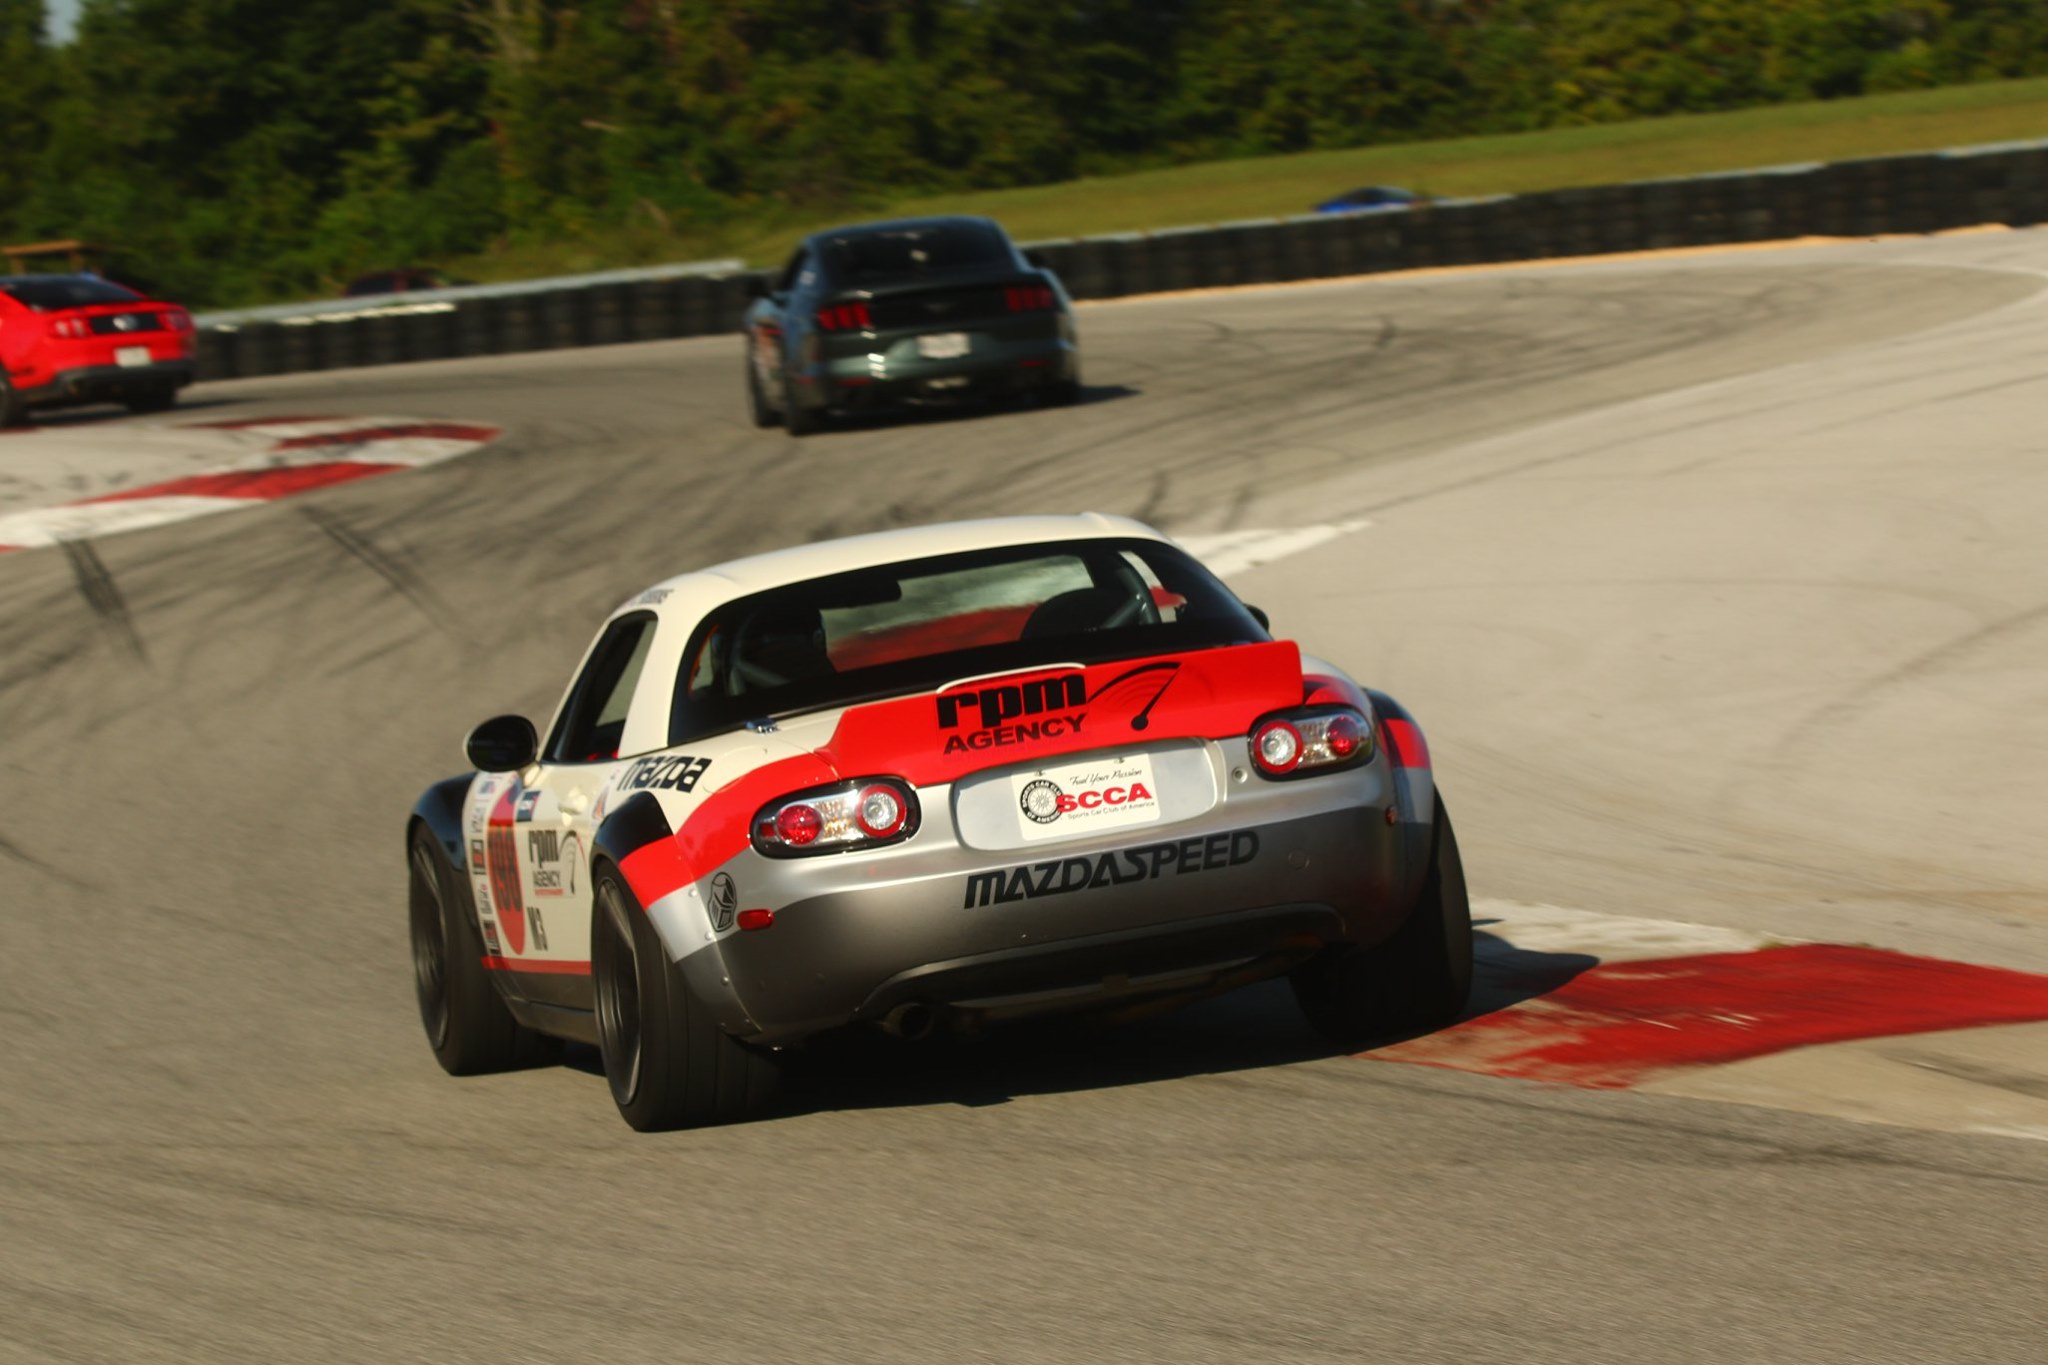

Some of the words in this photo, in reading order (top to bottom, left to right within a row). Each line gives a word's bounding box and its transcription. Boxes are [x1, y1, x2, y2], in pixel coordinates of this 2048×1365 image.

[936, 673, 1087, 729] rpm
[943, 714, 1088, 754] AGENCY
[616, 755, 713, 793] mazda
[1069, 774, 1088, 785] Fuel
[1089, 773, 1110, 786] Your
[1111, 768, 1143, 779] Passion
[1055, 782, 1152, 813] SCCA
[1067, 811, 1089, 820] Sports
[1091, 809, 1102, 817] Car
[1103, 807, 1119, 815] Club
[1128, 802, 1155, 810] America
[528, 829, 560, 869] rpm
[964, 831, 1260, 910] MAZDASPEED
